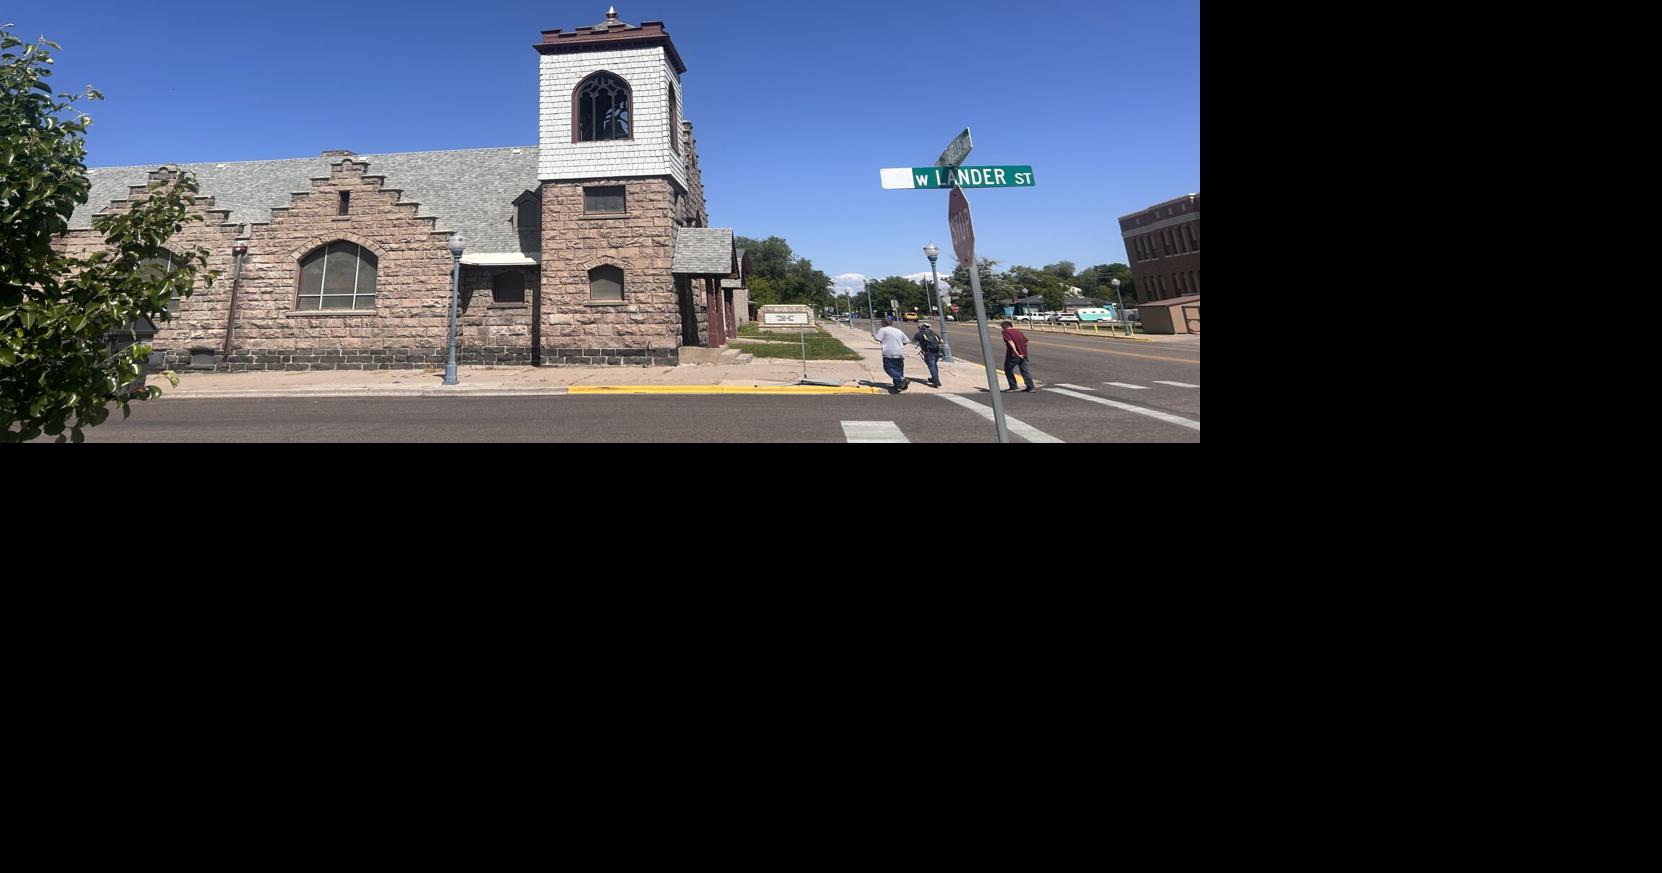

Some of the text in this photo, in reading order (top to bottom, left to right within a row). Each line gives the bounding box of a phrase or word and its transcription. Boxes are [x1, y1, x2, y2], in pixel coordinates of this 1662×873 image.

[915, 168, 1031, 186] W LANDER ST
[950, 208, 970, 245] STOP
